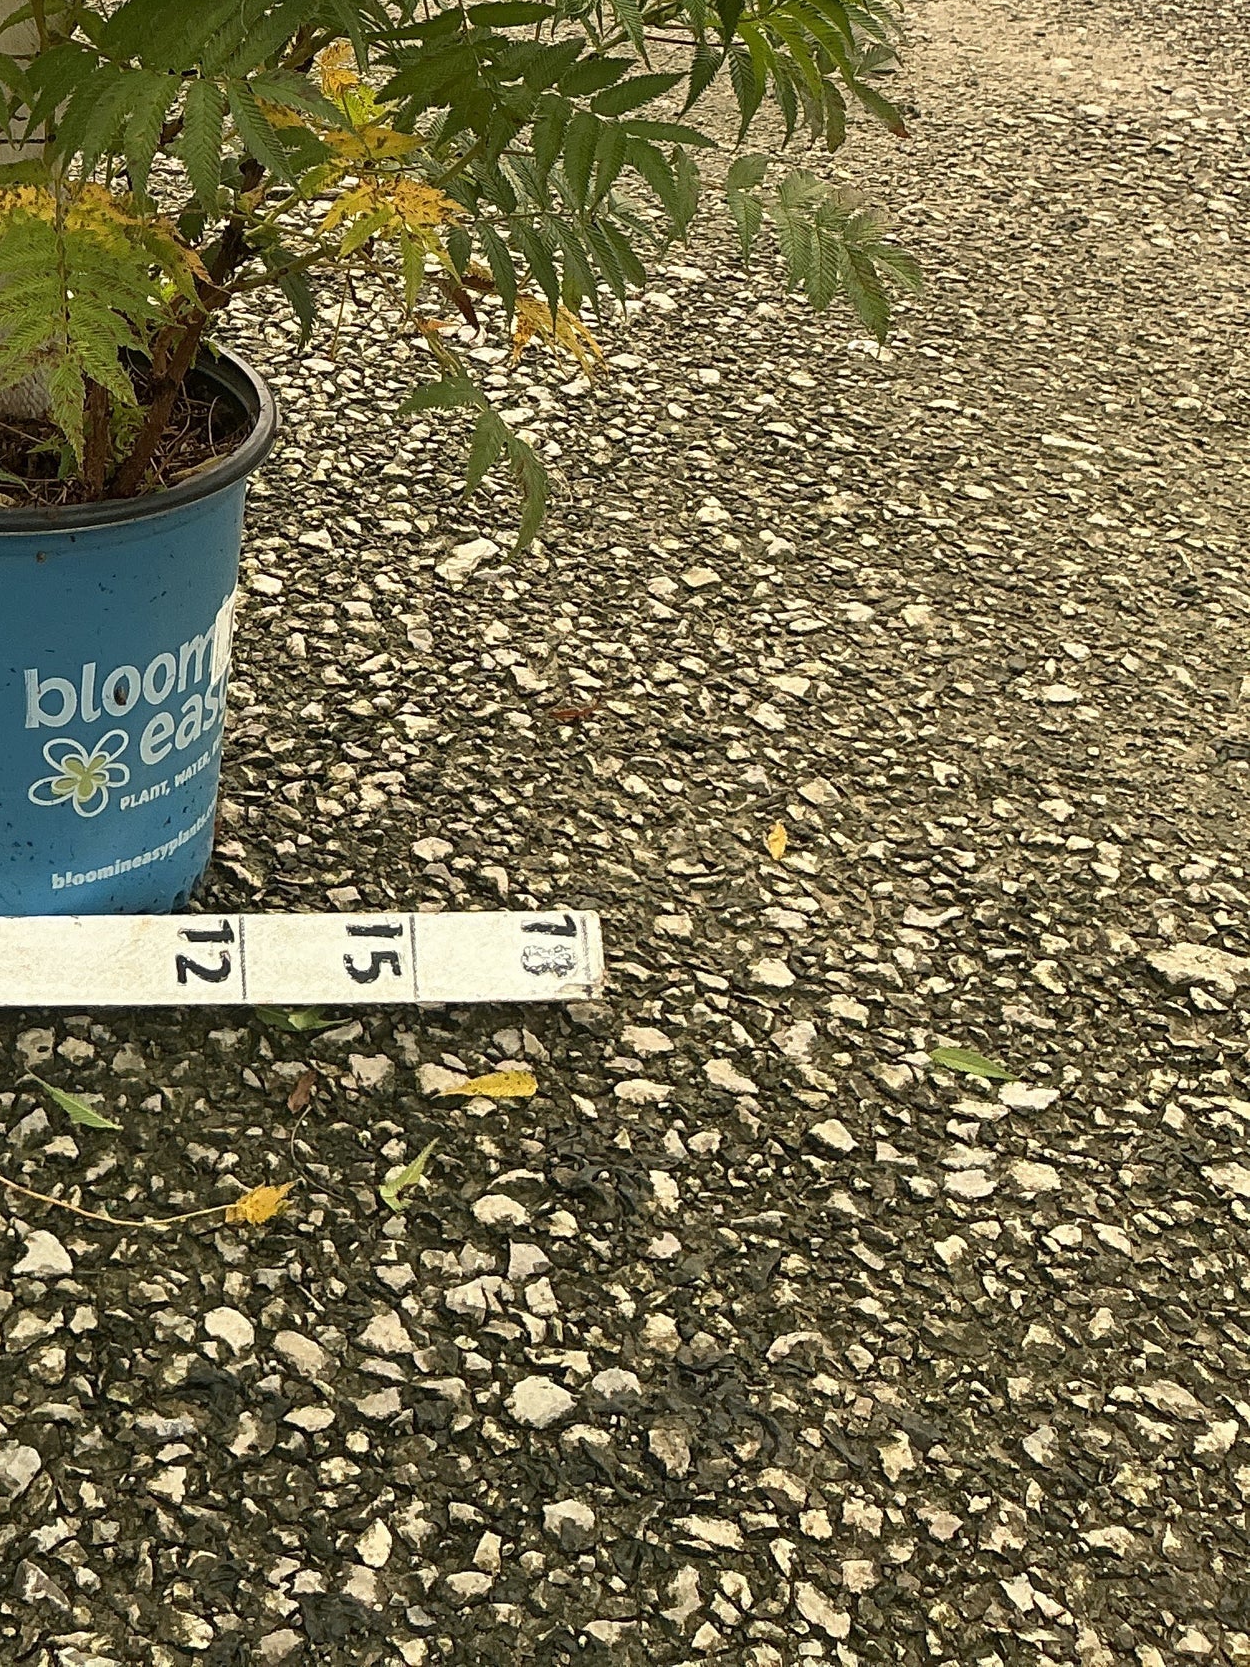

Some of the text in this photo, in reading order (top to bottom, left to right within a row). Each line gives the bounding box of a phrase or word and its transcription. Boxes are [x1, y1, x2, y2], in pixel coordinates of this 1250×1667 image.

[24, 598, 228, 729] bloom
[175, 919, 235, 986] 12
[343, 917, 403, 984] 15
[521, 914, 578, 978] 18
